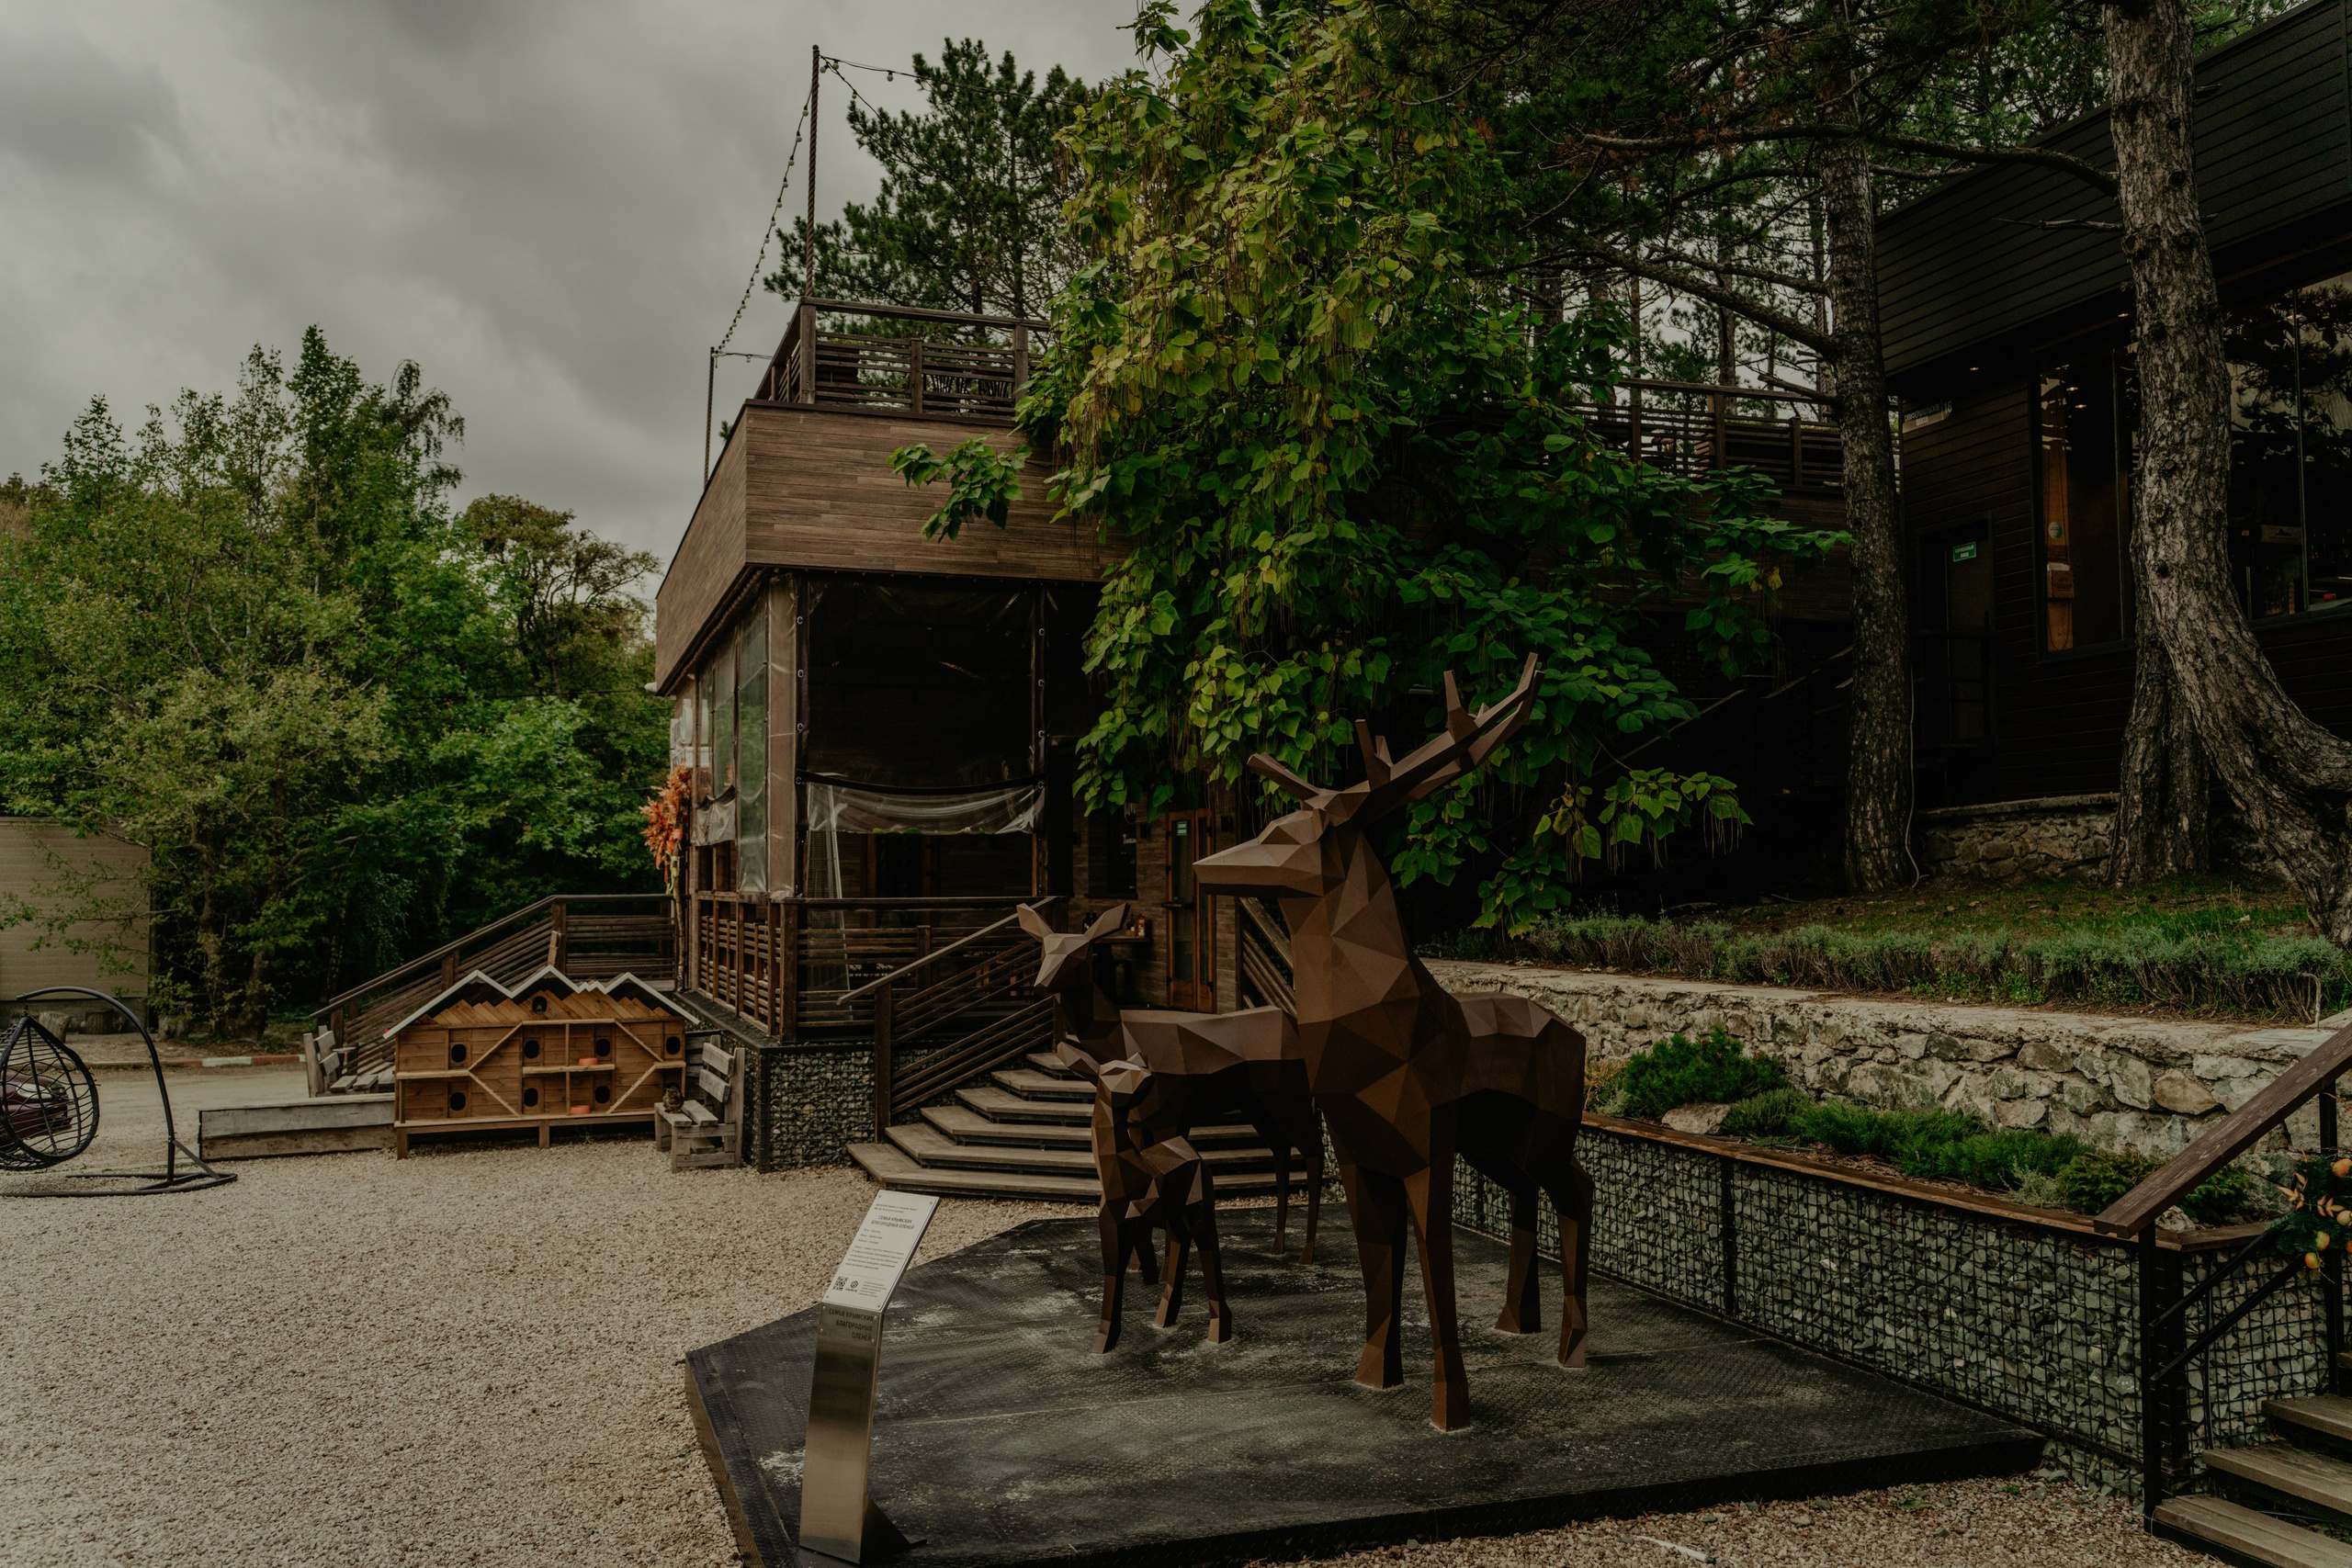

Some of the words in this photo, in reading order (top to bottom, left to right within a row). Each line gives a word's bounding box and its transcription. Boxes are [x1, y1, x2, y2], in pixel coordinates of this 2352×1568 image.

[1944, 400, 1952, 413] 16
[870, 1220, 899, 1228] БЛАГОРОДНЫХ
[829, 1308, 845, 1316] СЕМЬЯ
[845, 1311, 874, 1321] КРЫМСКИХ
[836, 1319, 873, 1331] БЛАГОРОДНЫХ
[852, 1332, 872, 1340] ОЛЕНЕЙ
